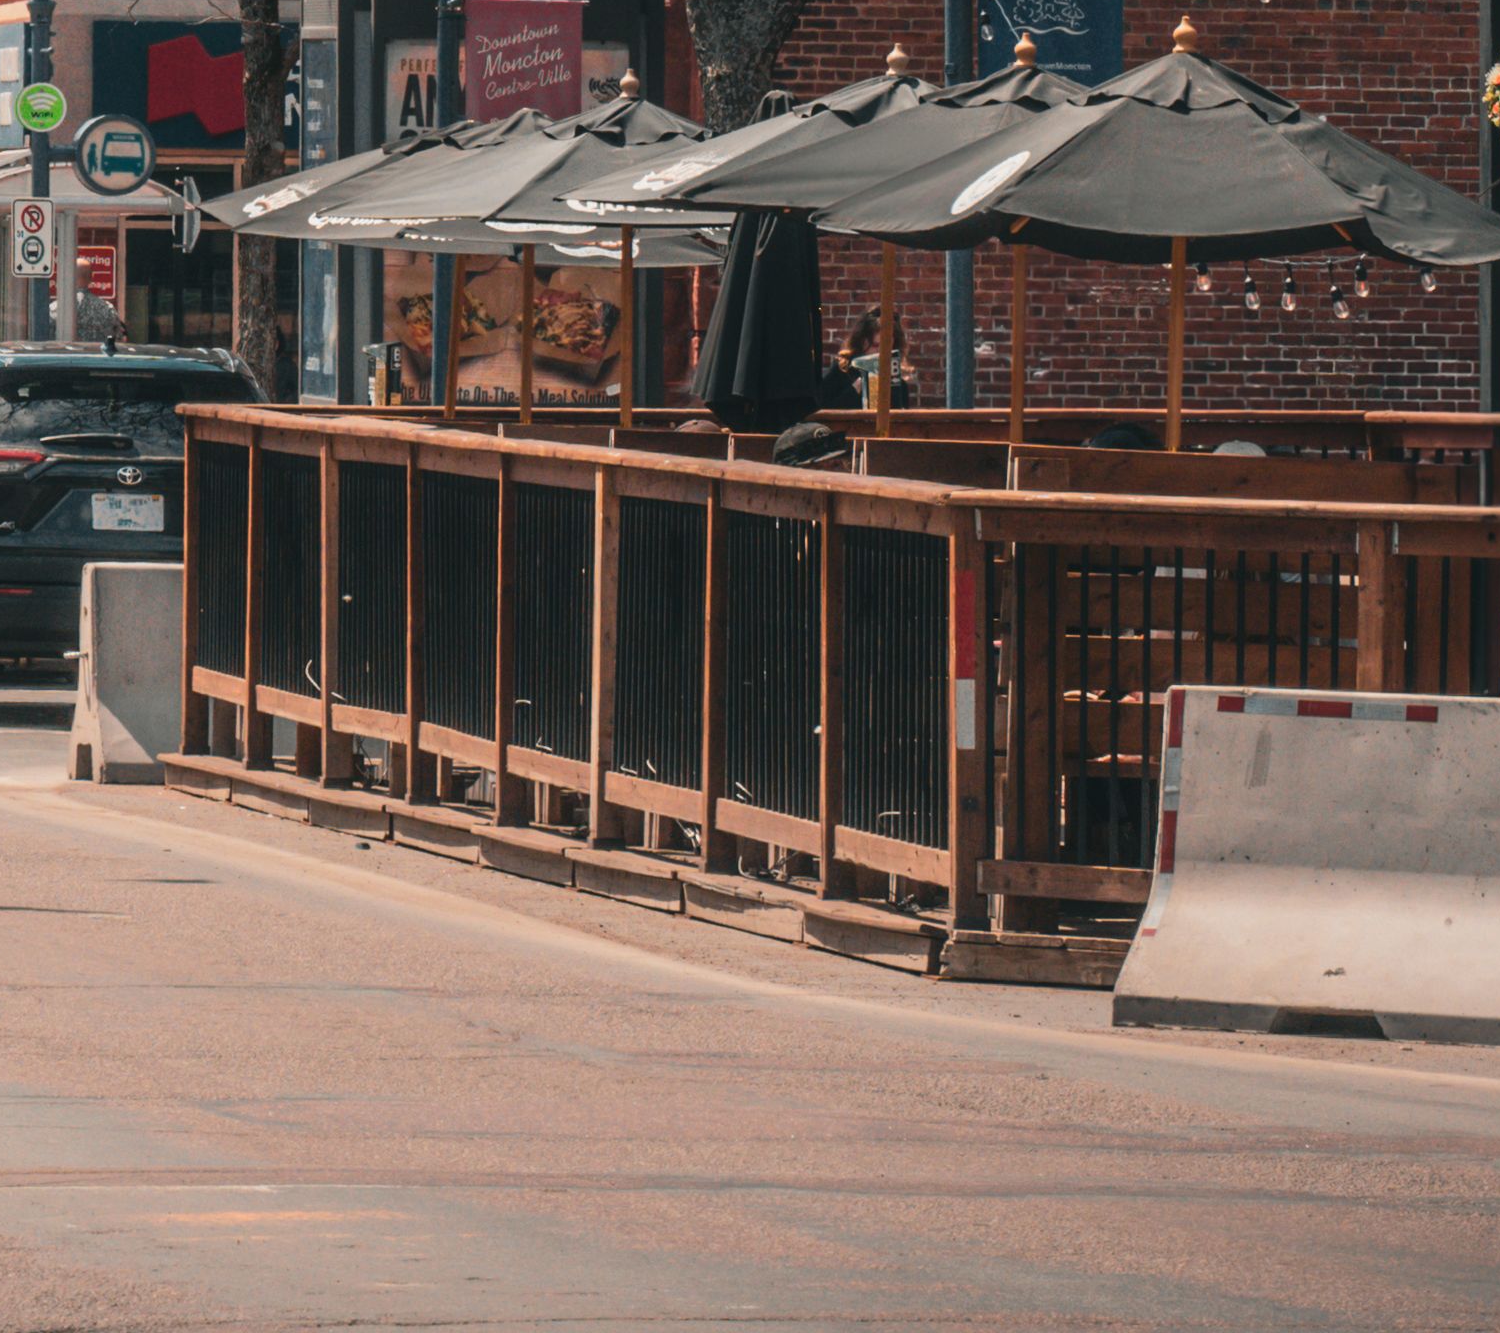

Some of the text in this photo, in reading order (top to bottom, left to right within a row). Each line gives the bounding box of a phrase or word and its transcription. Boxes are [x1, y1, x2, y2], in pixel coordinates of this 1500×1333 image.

[475, 23, 561, 54] Downtown
[400, 59, 437, 72] PERFE
[482, 43, 564, 80] Moncton
[485, 64, 573, 101] Centre-Ville
